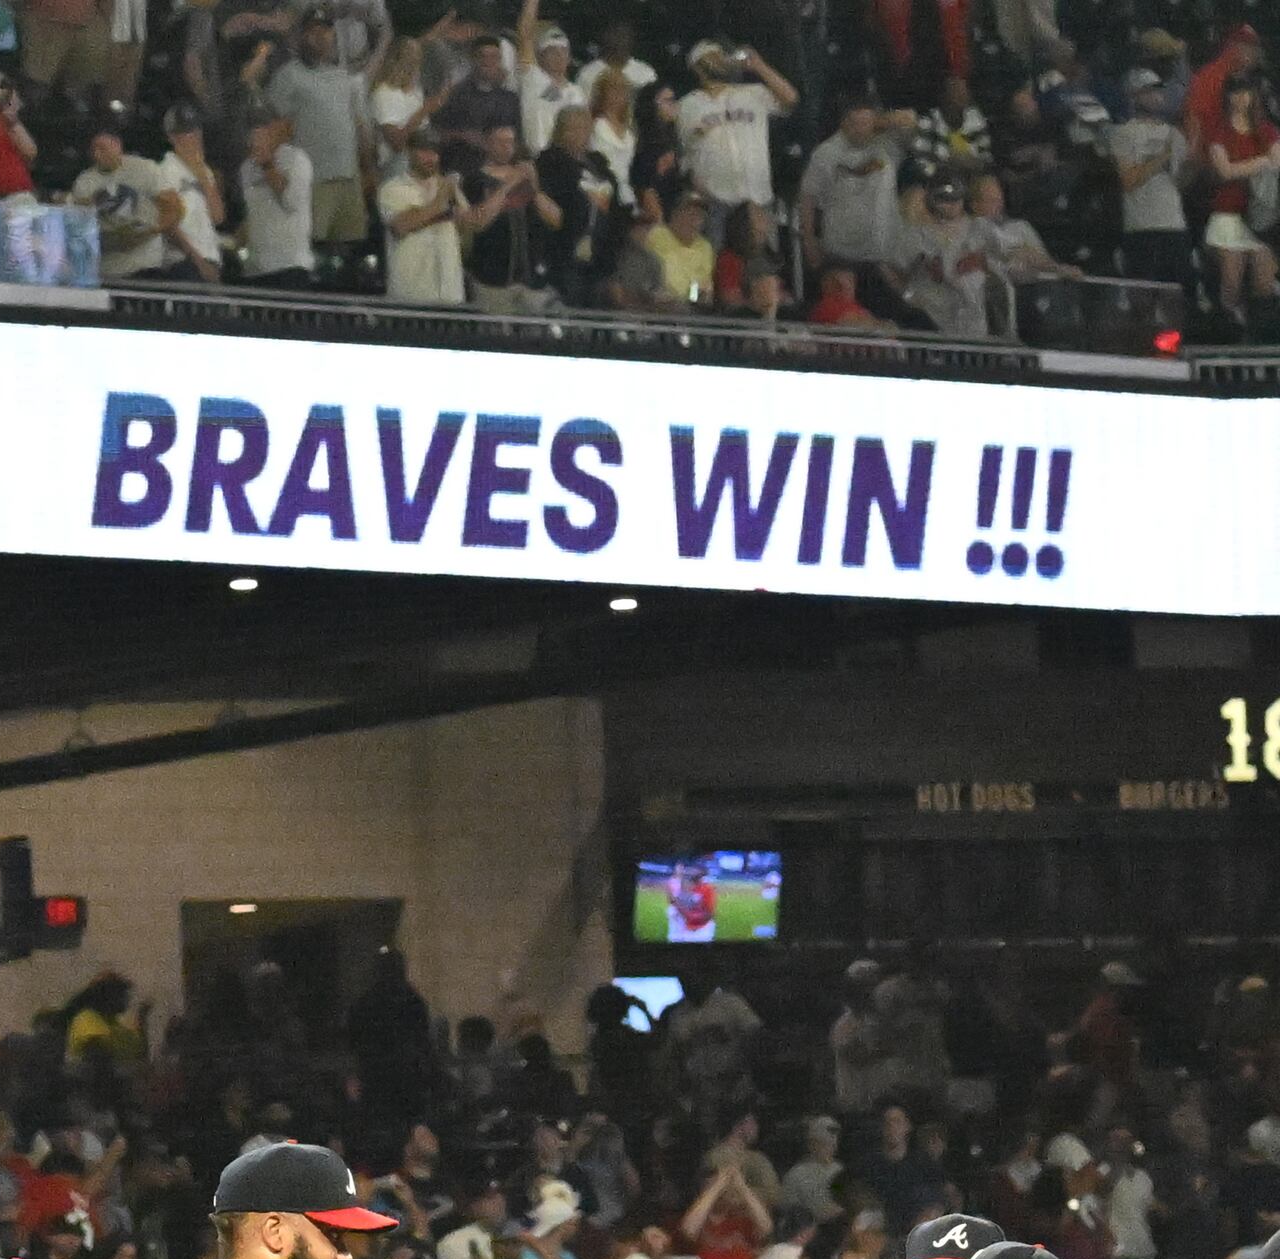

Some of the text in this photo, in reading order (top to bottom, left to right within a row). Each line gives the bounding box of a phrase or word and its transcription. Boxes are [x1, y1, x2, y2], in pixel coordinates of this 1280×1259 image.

[91, 391, 1073, 579] BRAVES WIN !!!
